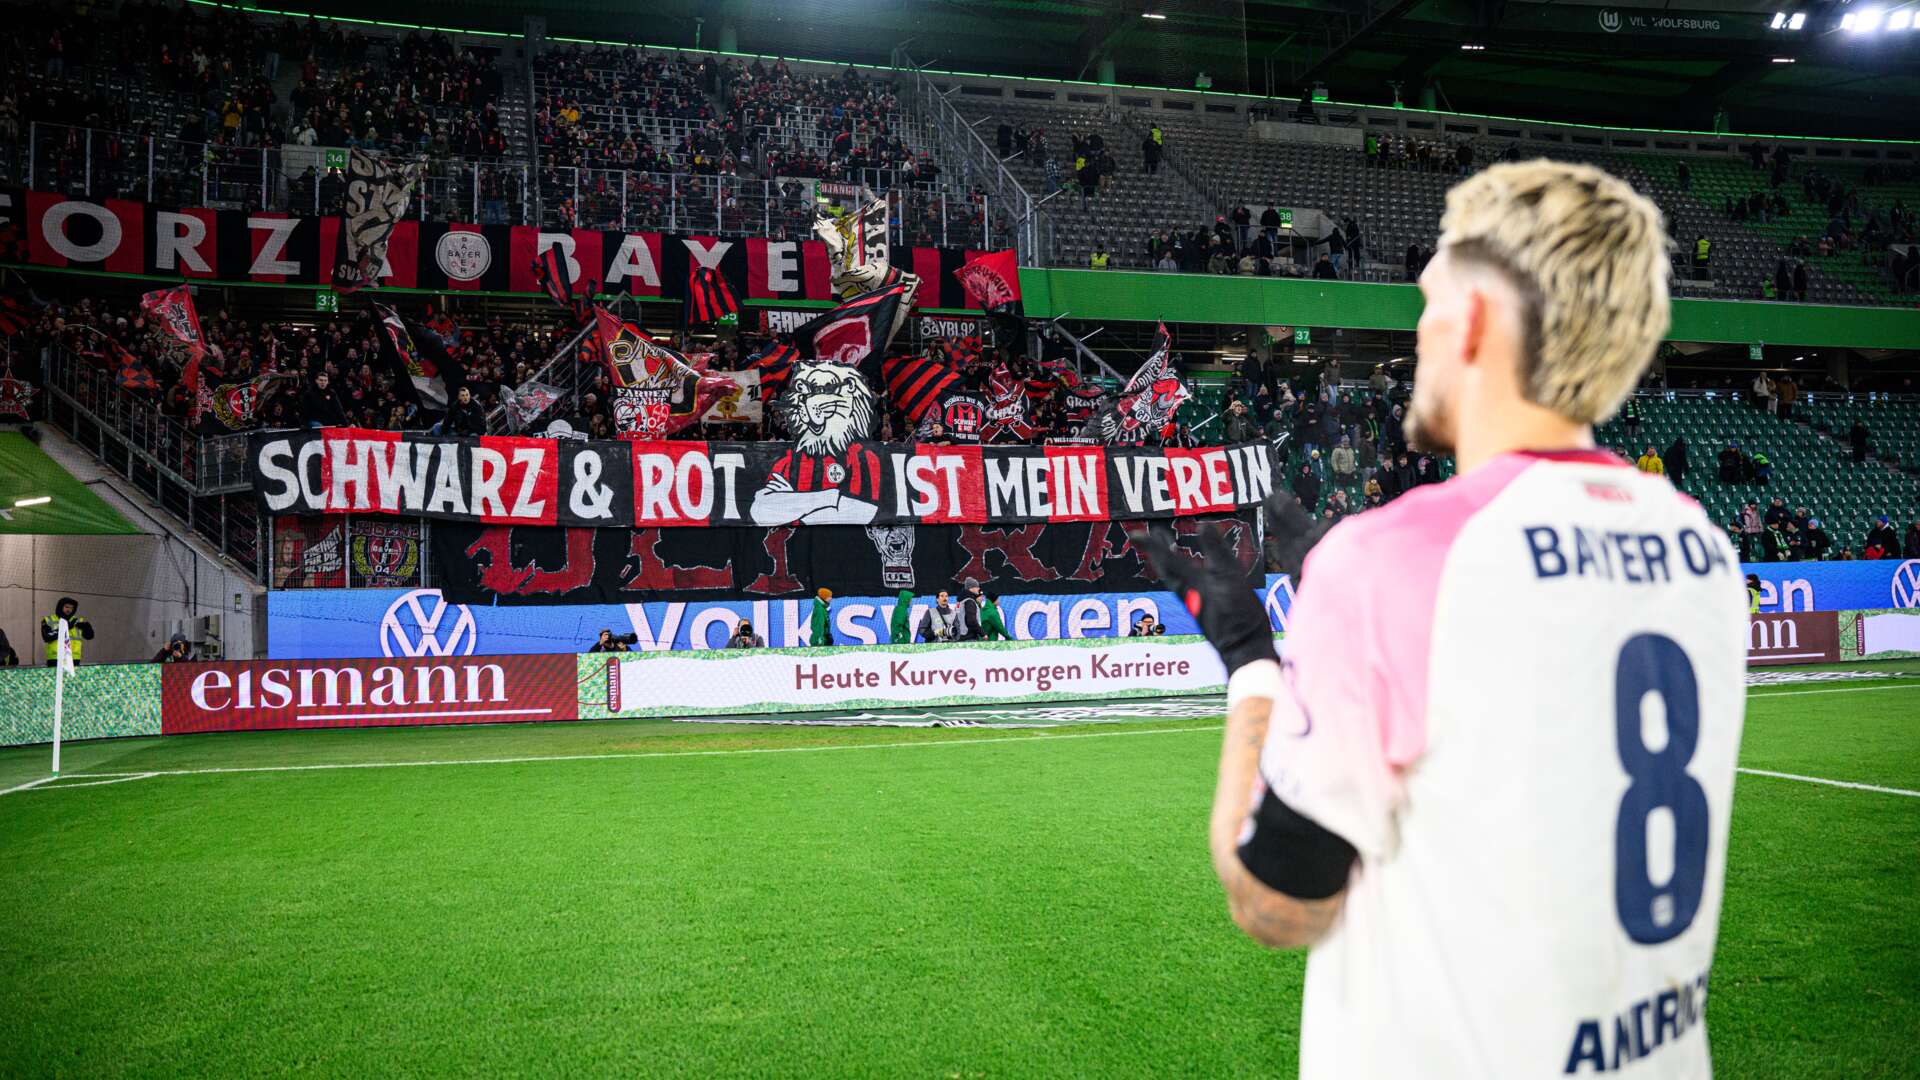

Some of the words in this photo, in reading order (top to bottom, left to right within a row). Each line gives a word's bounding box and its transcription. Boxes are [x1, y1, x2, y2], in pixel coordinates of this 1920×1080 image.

[1652, 16, 1720, 31] WOLFSBURG
[328, 154, 342, 164] 34
[1280, 212, 1292, 221] 38
[0, 194, 393, 278] ORZ
[318, 295, 337, 306] 33
[1295, 330, 1310, 341] 37
[257, 439, 546, 518] SCHWARZ
[569, 449, 615, 519] &
[638, 450, 746, 520] ROT
[892, 453, 966, 516] IST
[984, 454, 1103, 517] MEIN
[1114, 445, 1272, 513] VEREIN
[1523, 526, 1671, 582] BAYER
[190, 664, 509, 711] eismann
[795, 663, 880, 690] Heute
[890, 660, 976, 690] Kurve,
[985, 657, 1081, 691] morgen
[1091, 653, 1190, 679] Karriere
[1615, 632, 1710, 946] 8
